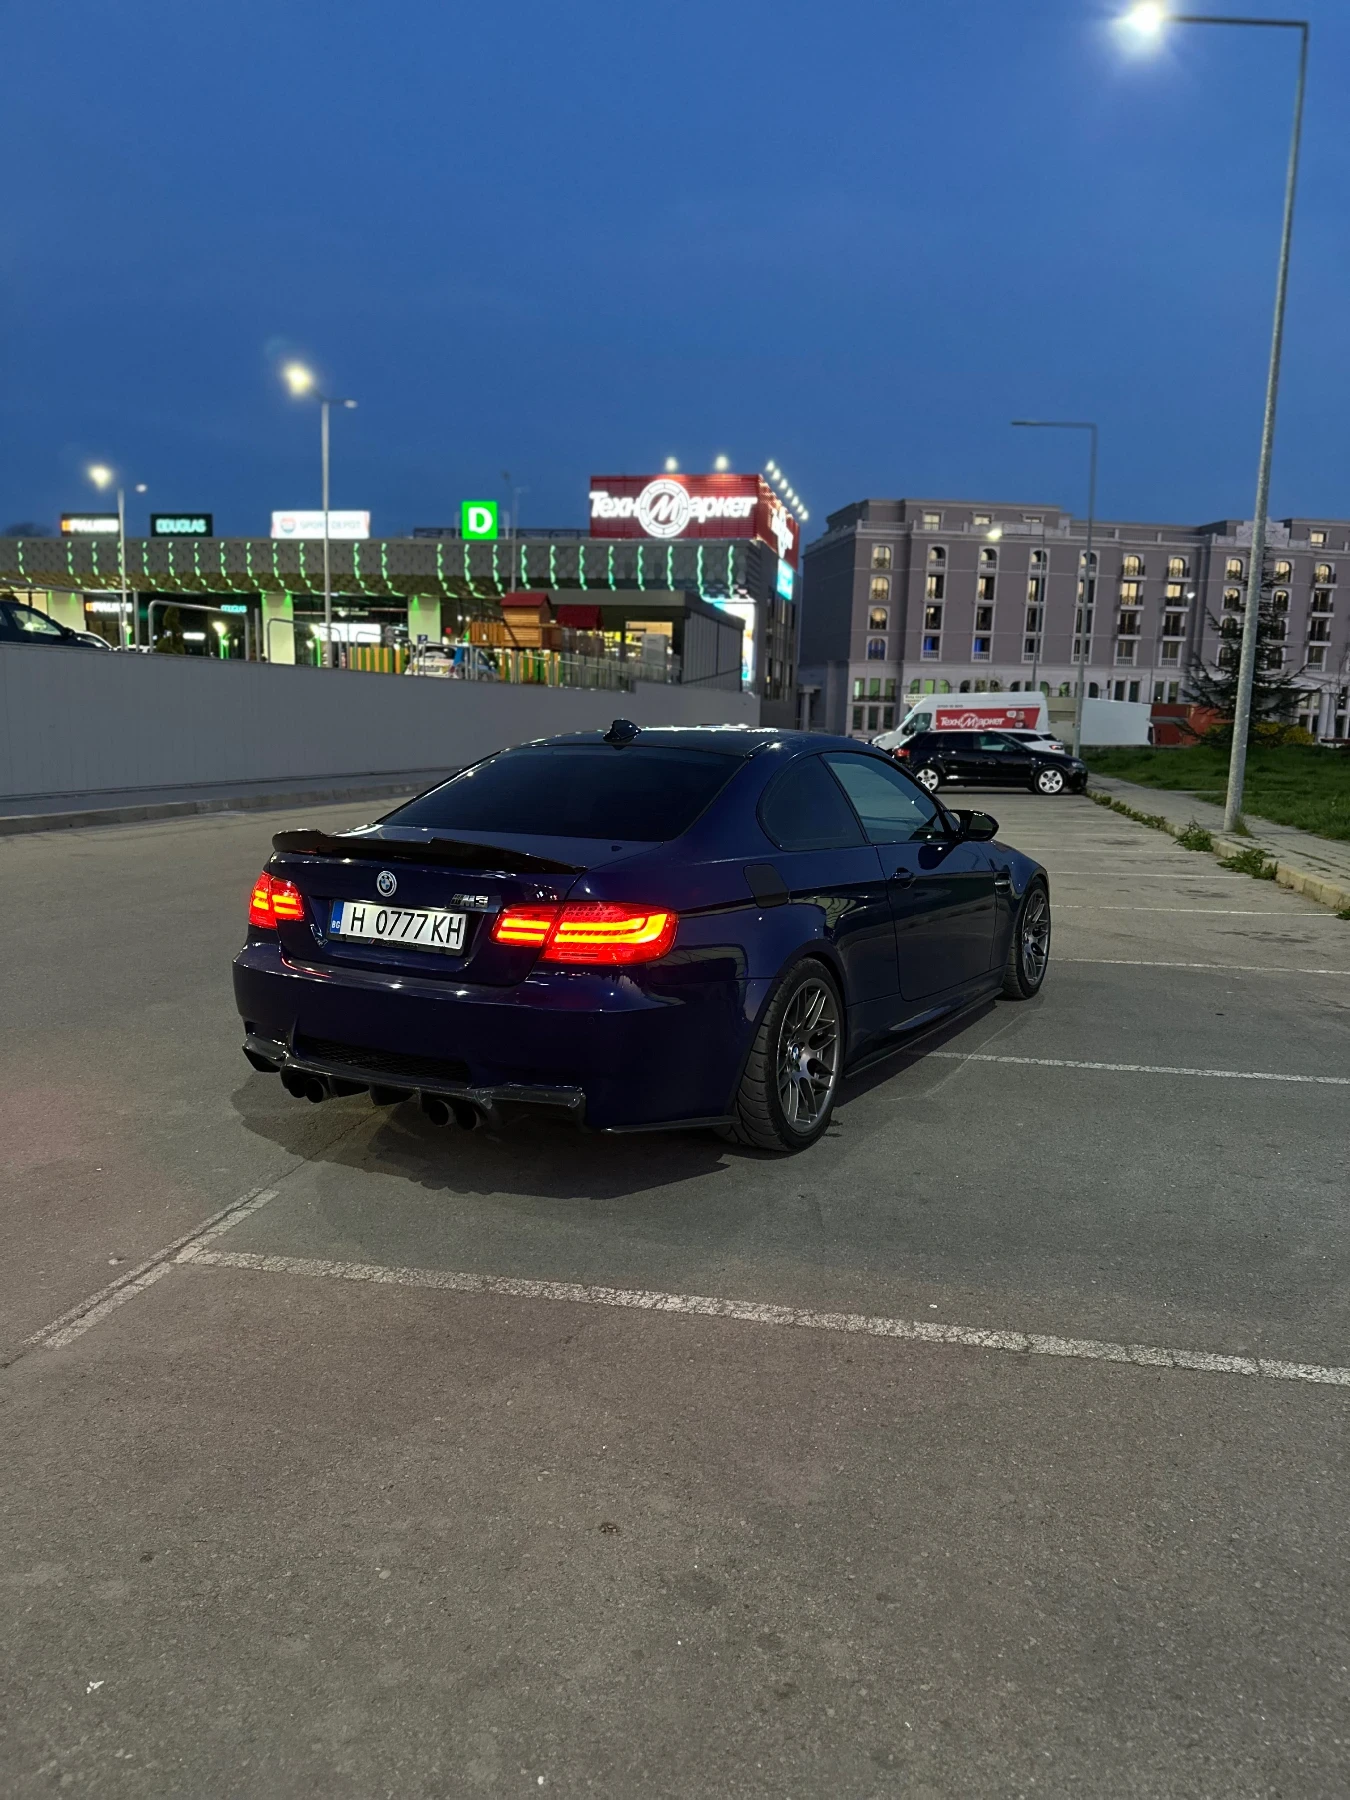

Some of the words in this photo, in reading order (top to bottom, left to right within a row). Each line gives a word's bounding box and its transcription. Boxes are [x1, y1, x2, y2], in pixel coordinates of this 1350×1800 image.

[155, 518, 206, 533] DOUGLAS
[468, 507, 493, 534] D
[331, 920, 341, 929] BG
[350, 906, 366, 933] H
